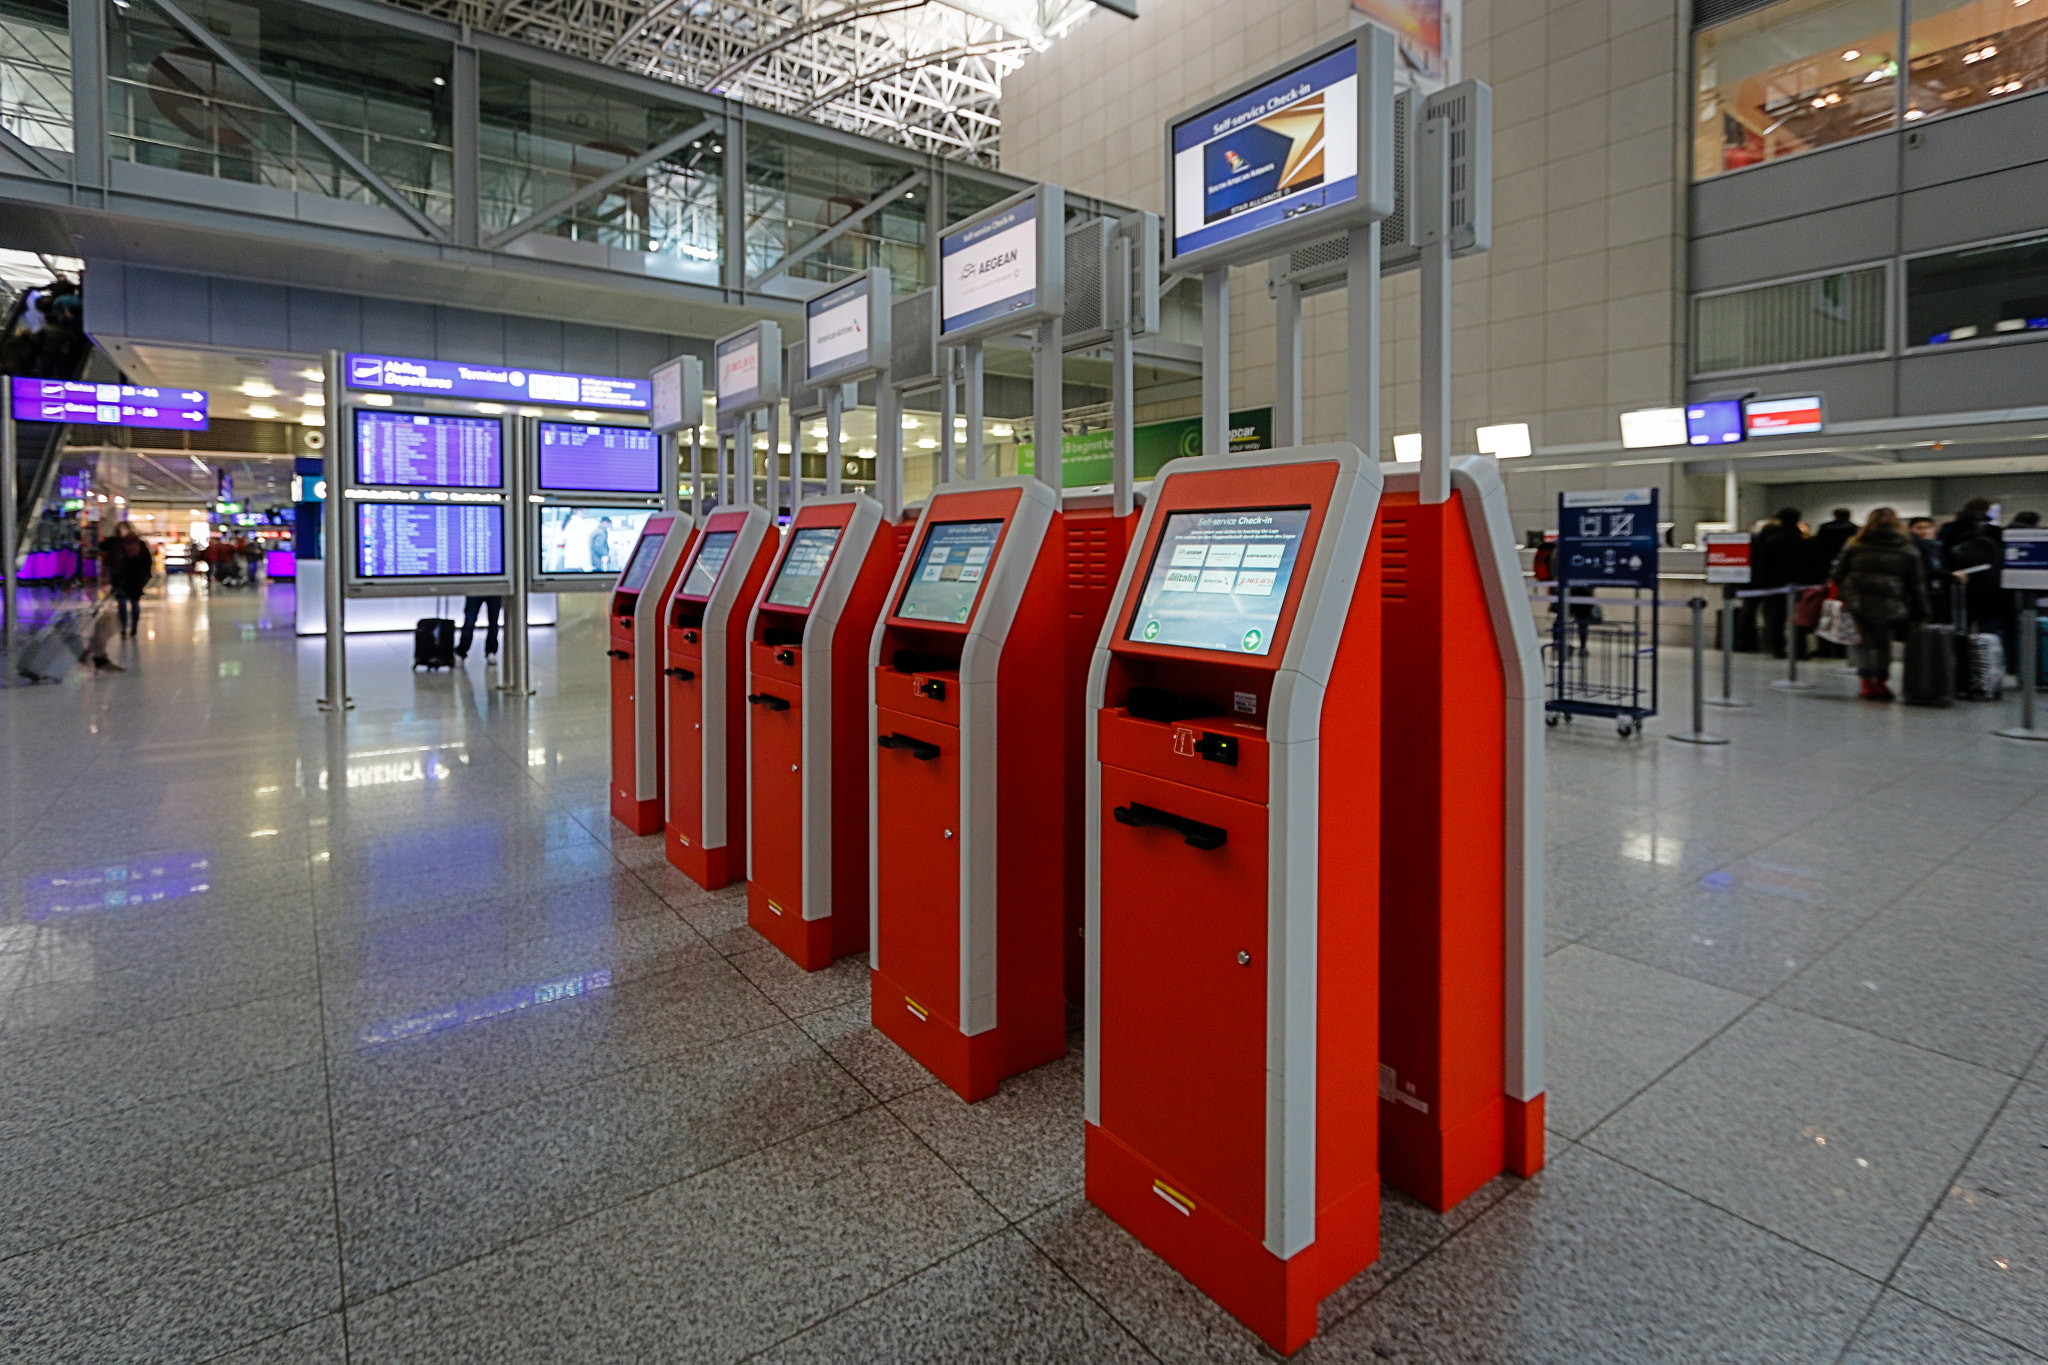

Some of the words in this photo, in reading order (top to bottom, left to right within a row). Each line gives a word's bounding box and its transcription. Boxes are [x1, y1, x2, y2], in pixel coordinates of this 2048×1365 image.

[1212, 104, 1265, 135] Self-service
[1267, 83, 1311, 111] Check-in
[1230, 204, 1248, 215] STAR
[1249, 190, 1283, 208] ALLIANCE
[978, 248, 1018, 275] AEGEAN
[384, 360, 427, 378] Abflug
[458, 367, 508, 383] Terminal
[64, 382, 96, 392] Gates
[385, 372, 453, 389] Departures
[65, 403, 96, 413] Gates
[1198, 517, 1237, 526] Self-service
[1238, 515, 1273, 525] Check-in
[1167, 572, 1198, 583] Alitalia
